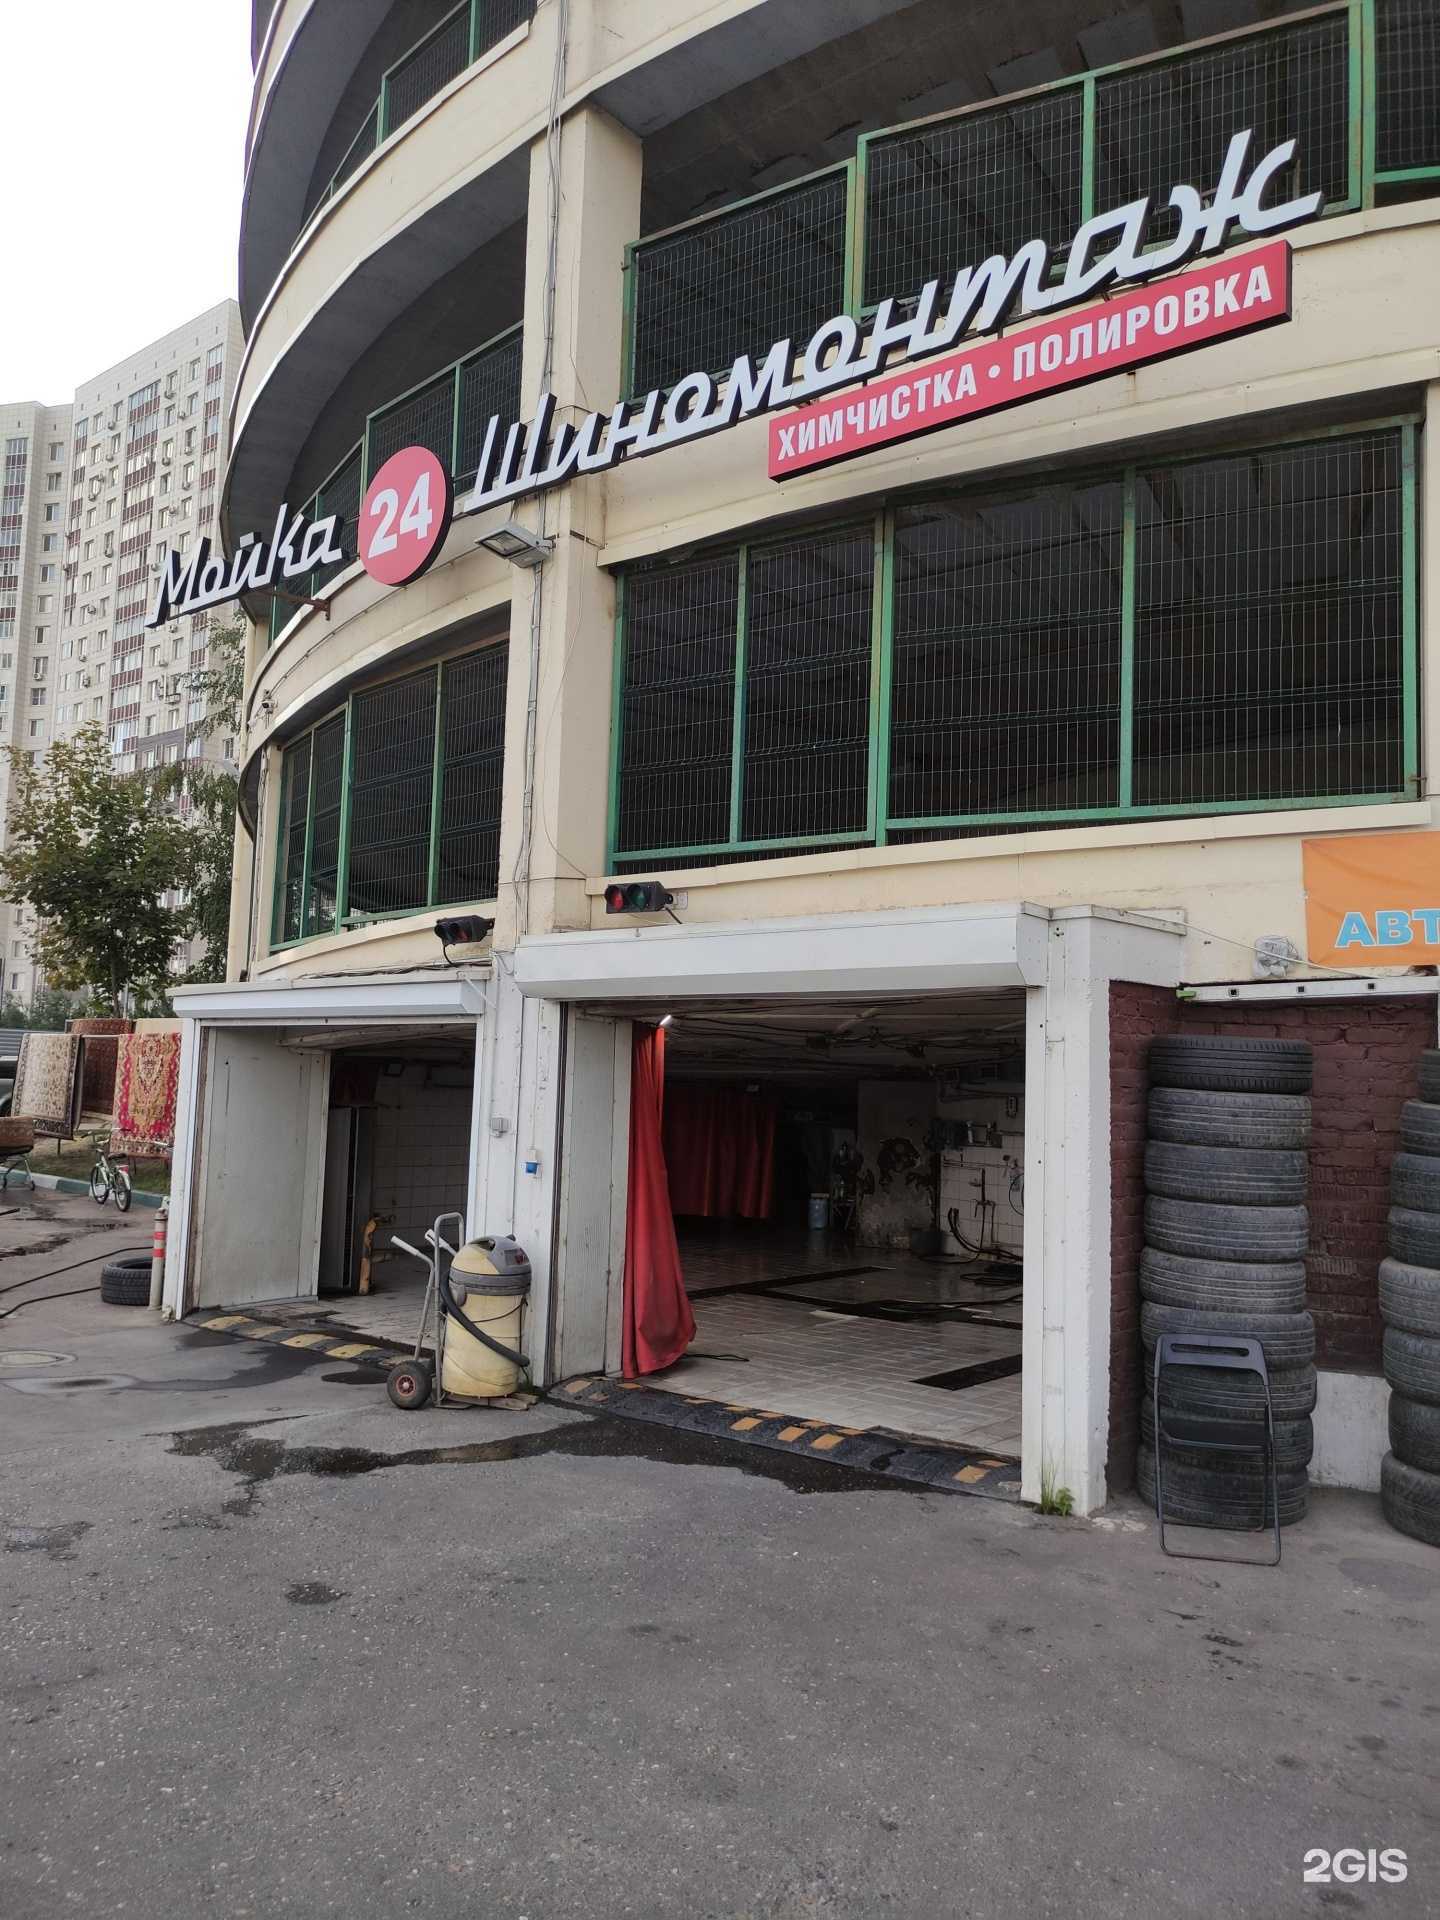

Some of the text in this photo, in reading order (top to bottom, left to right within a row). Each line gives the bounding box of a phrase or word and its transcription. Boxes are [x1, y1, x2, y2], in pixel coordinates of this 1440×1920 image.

[145, 128, 1322, 627] Мойка 24 Шиномонтаж
[777, 265, 1272, 460] ХИМЧИСТКА ПОЛИРОВКА
